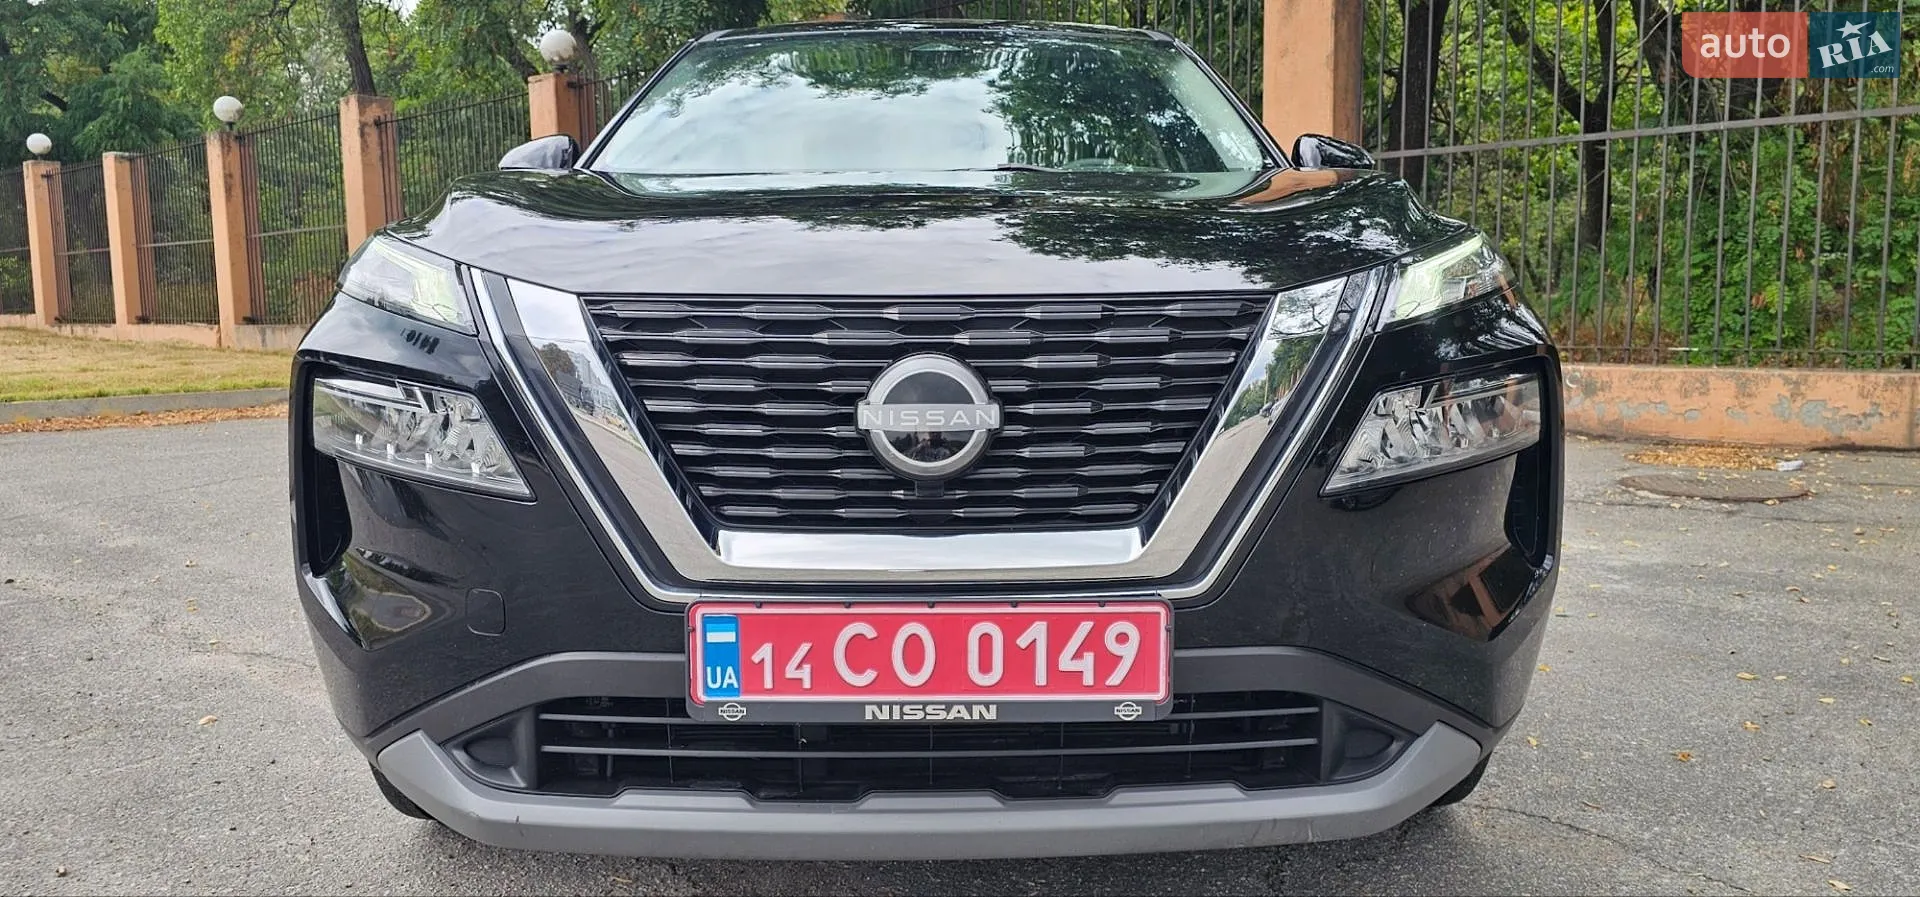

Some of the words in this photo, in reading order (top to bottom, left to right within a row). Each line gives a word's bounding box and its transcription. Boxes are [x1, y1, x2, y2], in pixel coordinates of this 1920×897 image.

[862, 409, 995, 426] NISSAN
[751, 642, 813, 690] 14
[833, 622, 936, 688] CO
[967, 620, 1141, 687] 0149
[706, 665, 739, 689] UA
[864, 704, 998, 720] NISSAN
